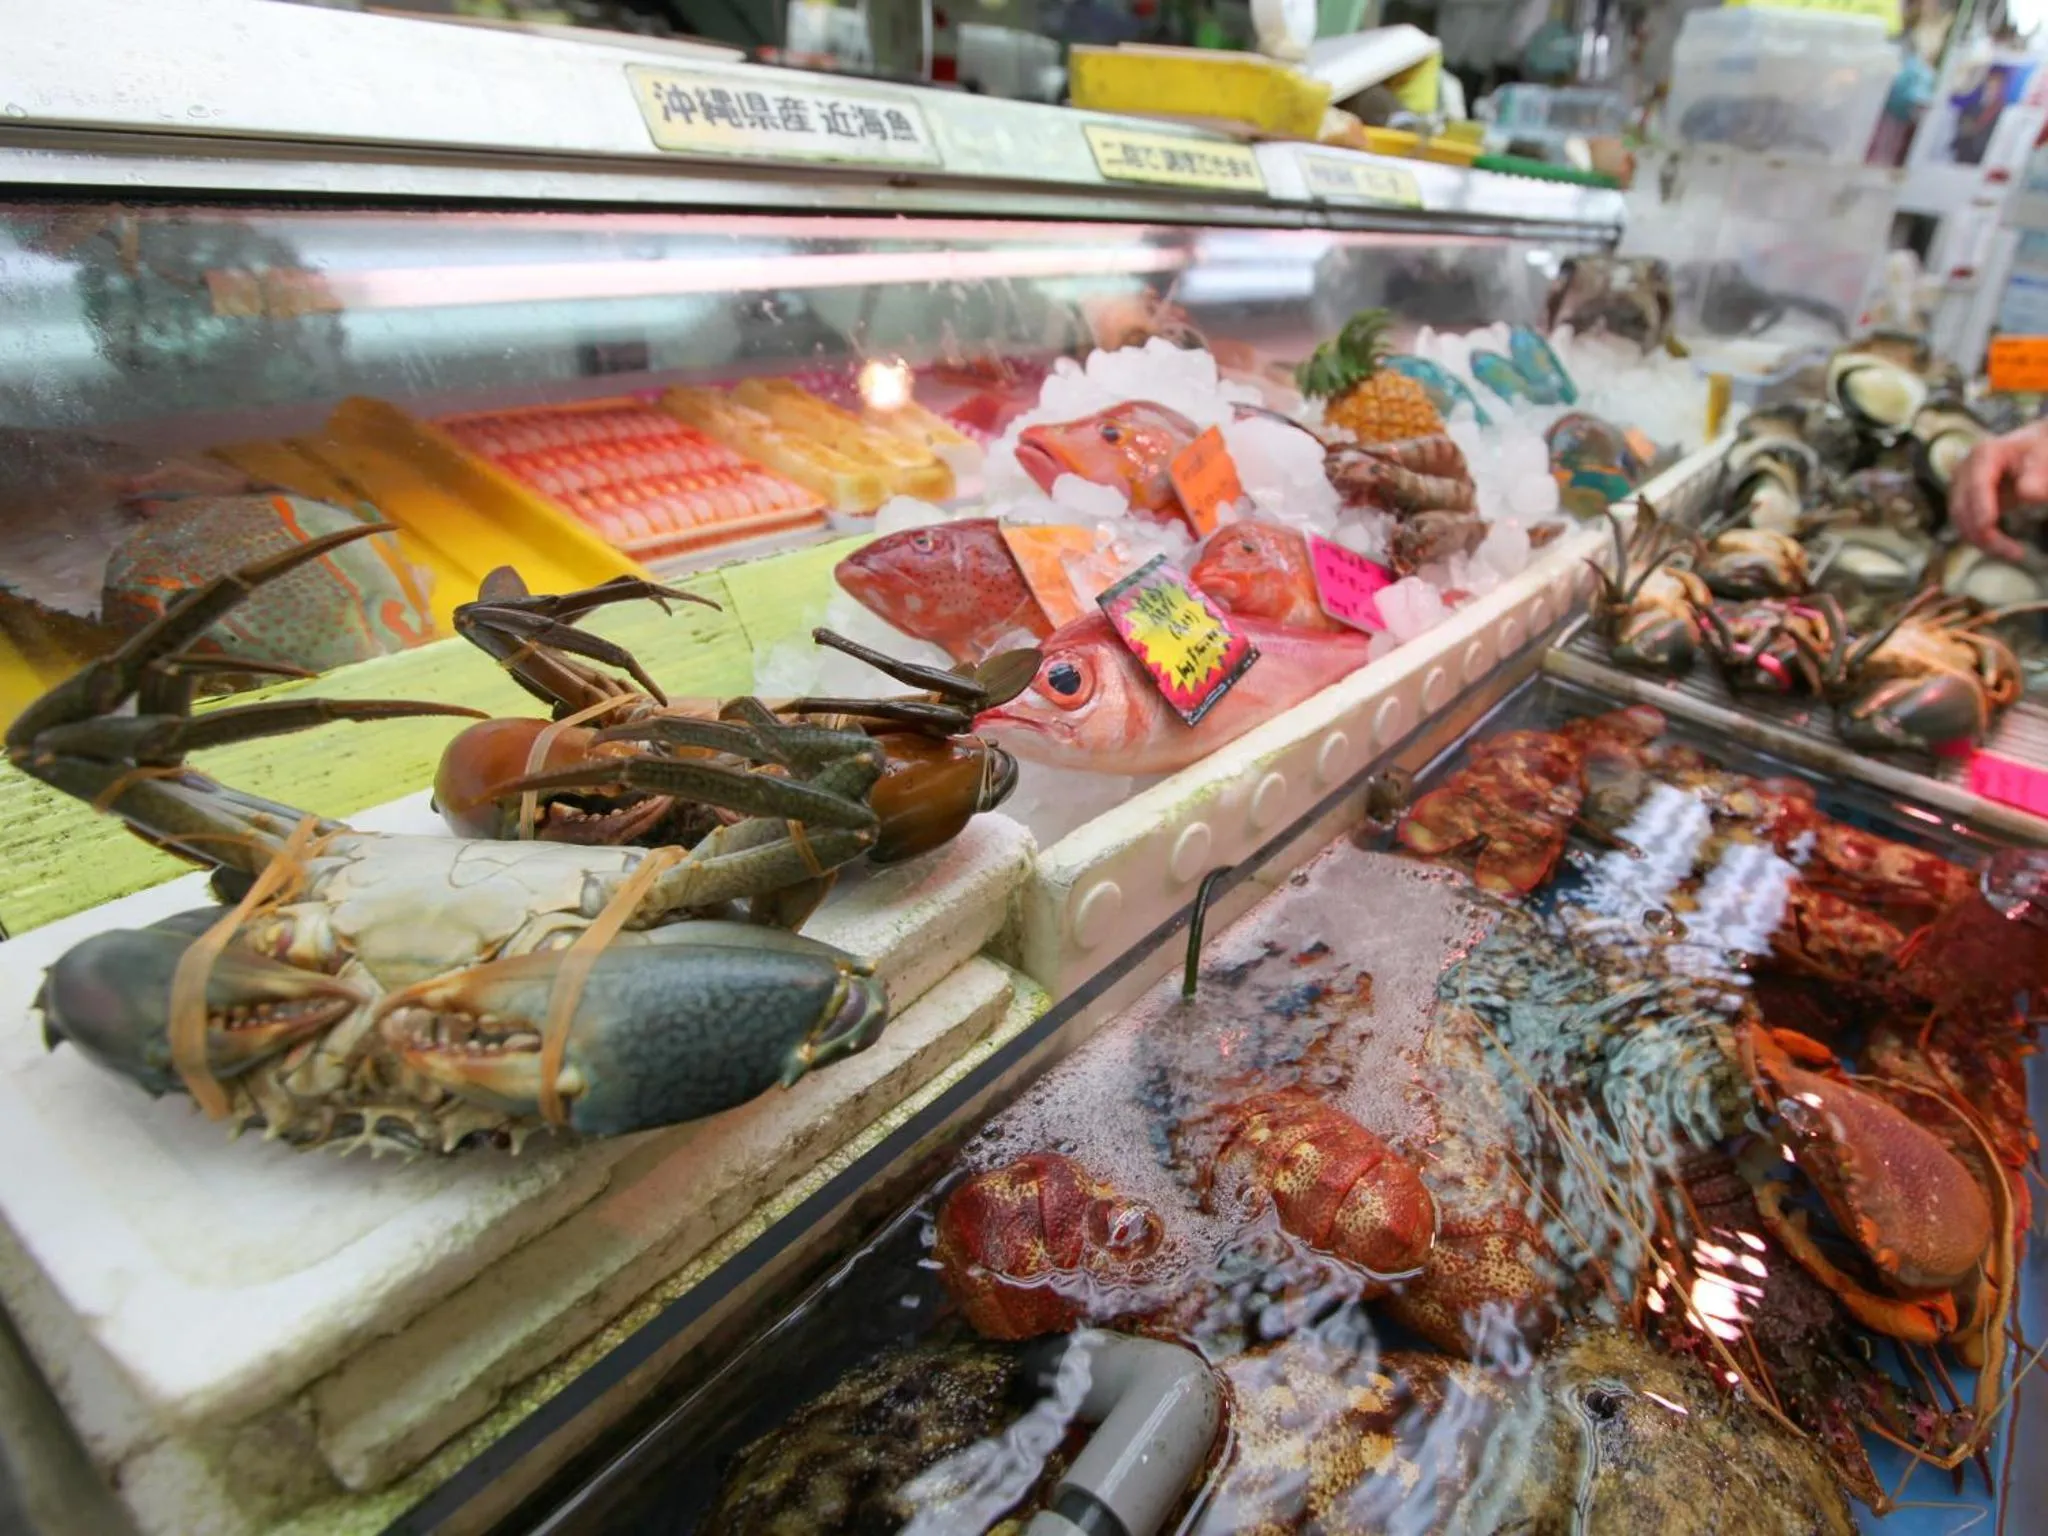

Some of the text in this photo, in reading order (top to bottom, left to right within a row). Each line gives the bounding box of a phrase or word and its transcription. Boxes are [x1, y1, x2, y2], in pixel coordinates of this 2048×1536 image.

[654, 82, 919, 142] 沖縄県産 近海魚
